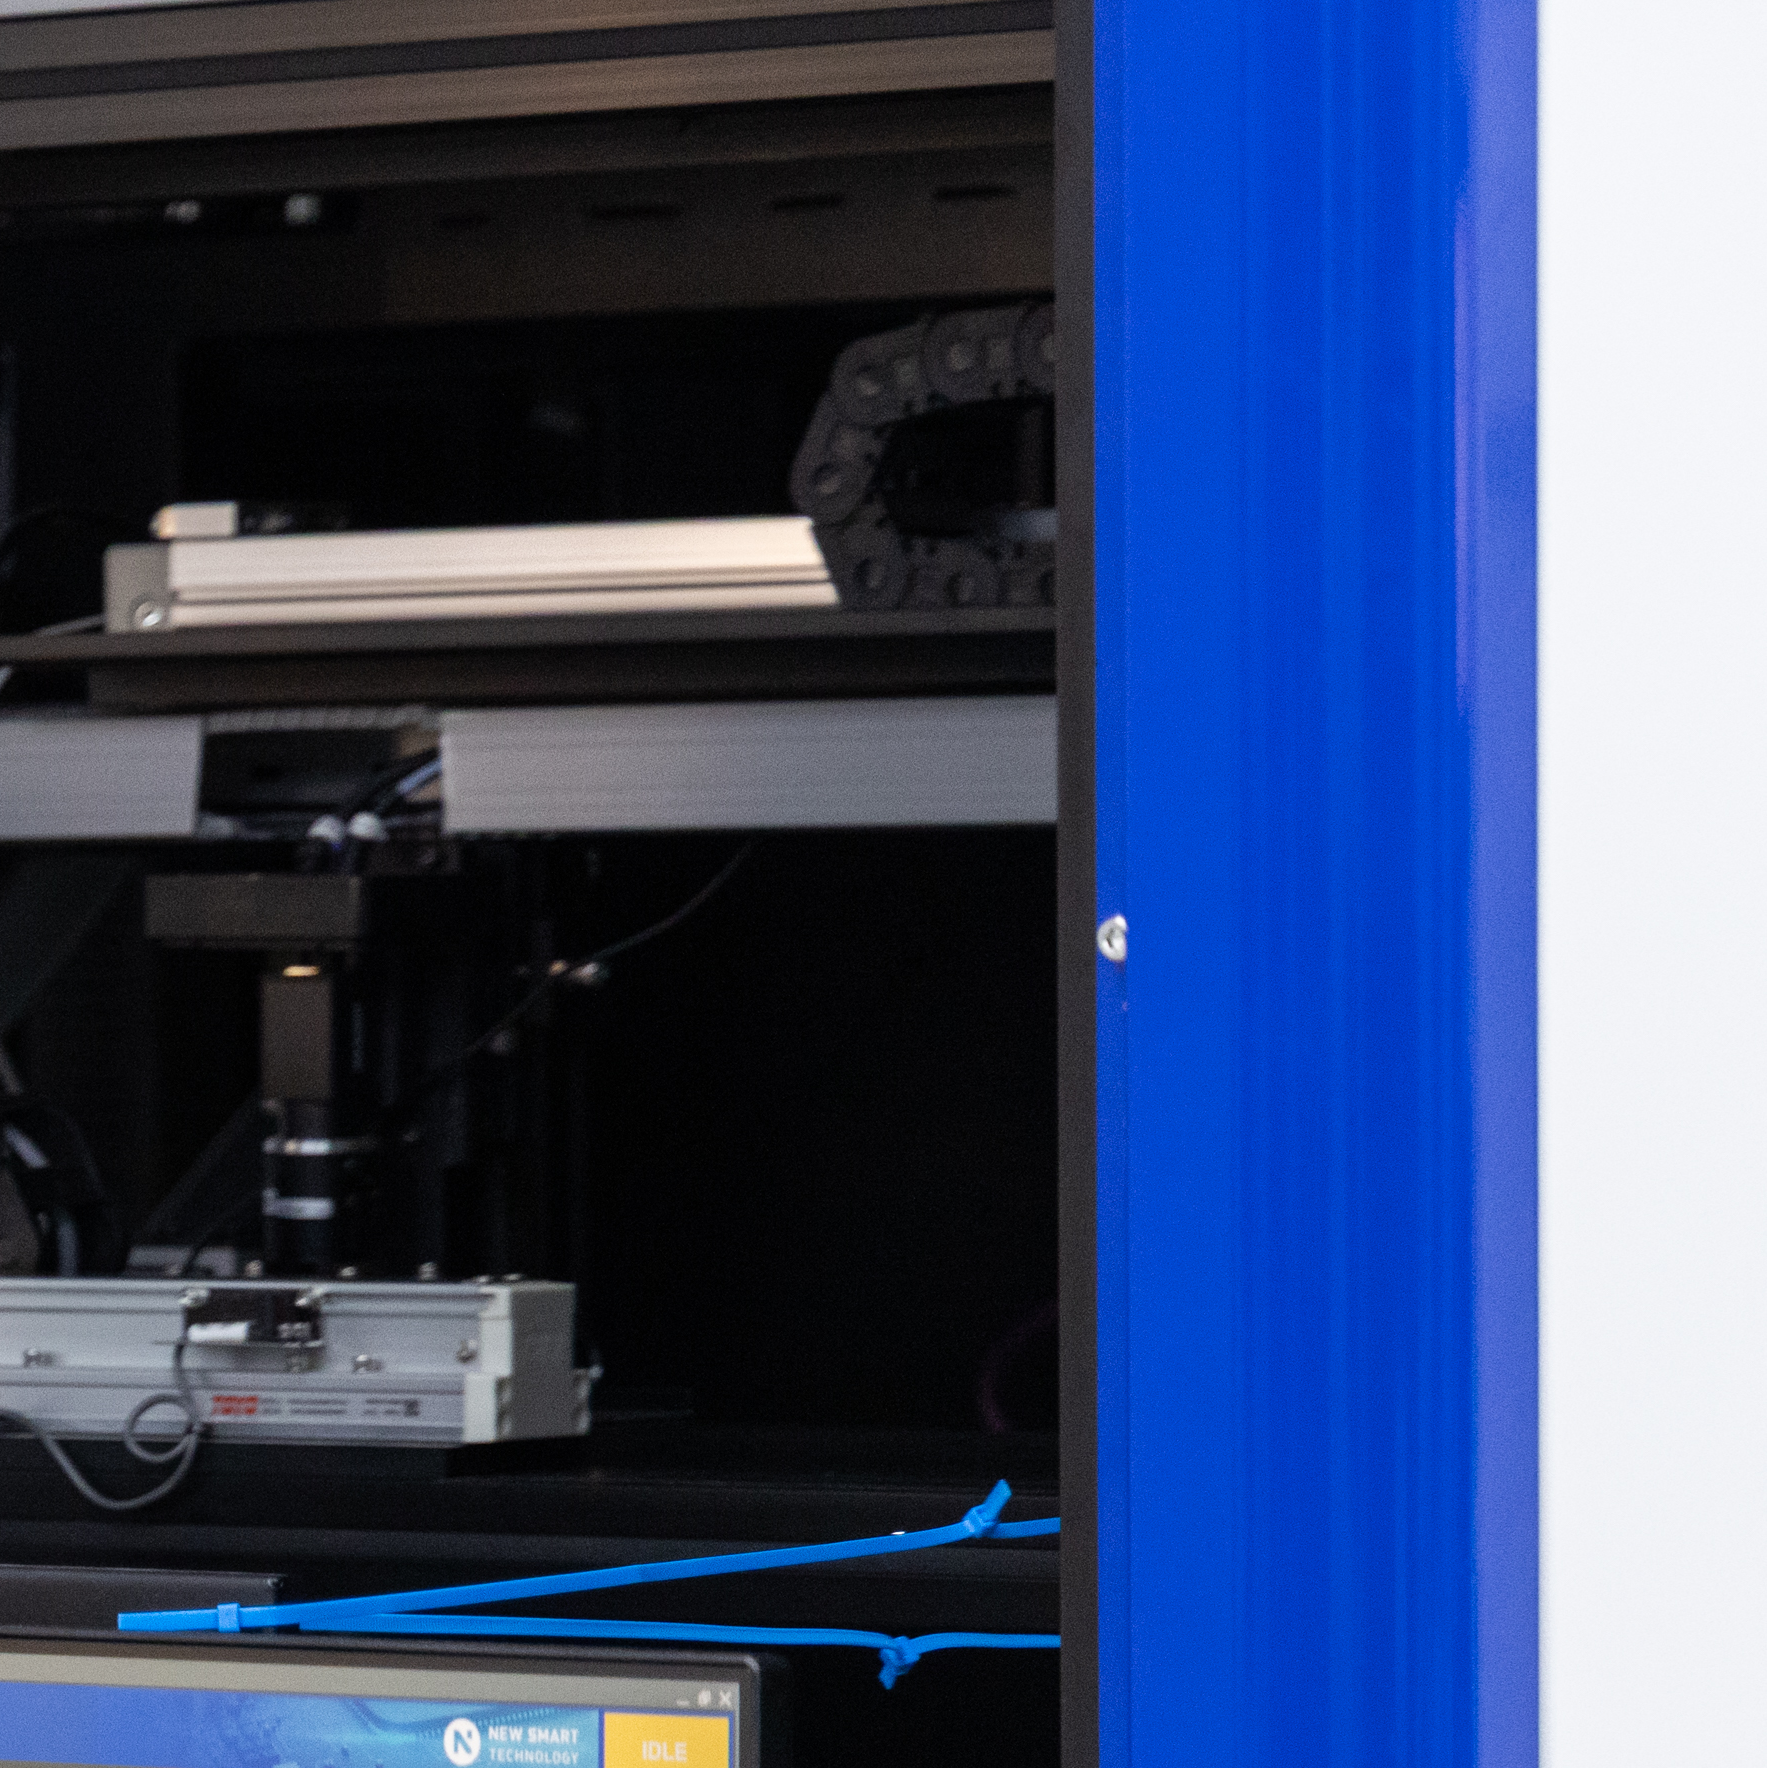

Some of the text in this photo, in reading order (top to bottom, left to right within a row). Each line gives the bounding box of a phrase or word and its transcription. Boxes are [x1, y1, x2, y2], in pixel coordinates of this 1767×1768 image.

[488, 1725, 523, 1743] NEW
[527, 1727, 579, 1745] SMART
[488, 1747, 579, 1766] TECHNOLOGY
[641, 1740, 688, 1763] IDLE
